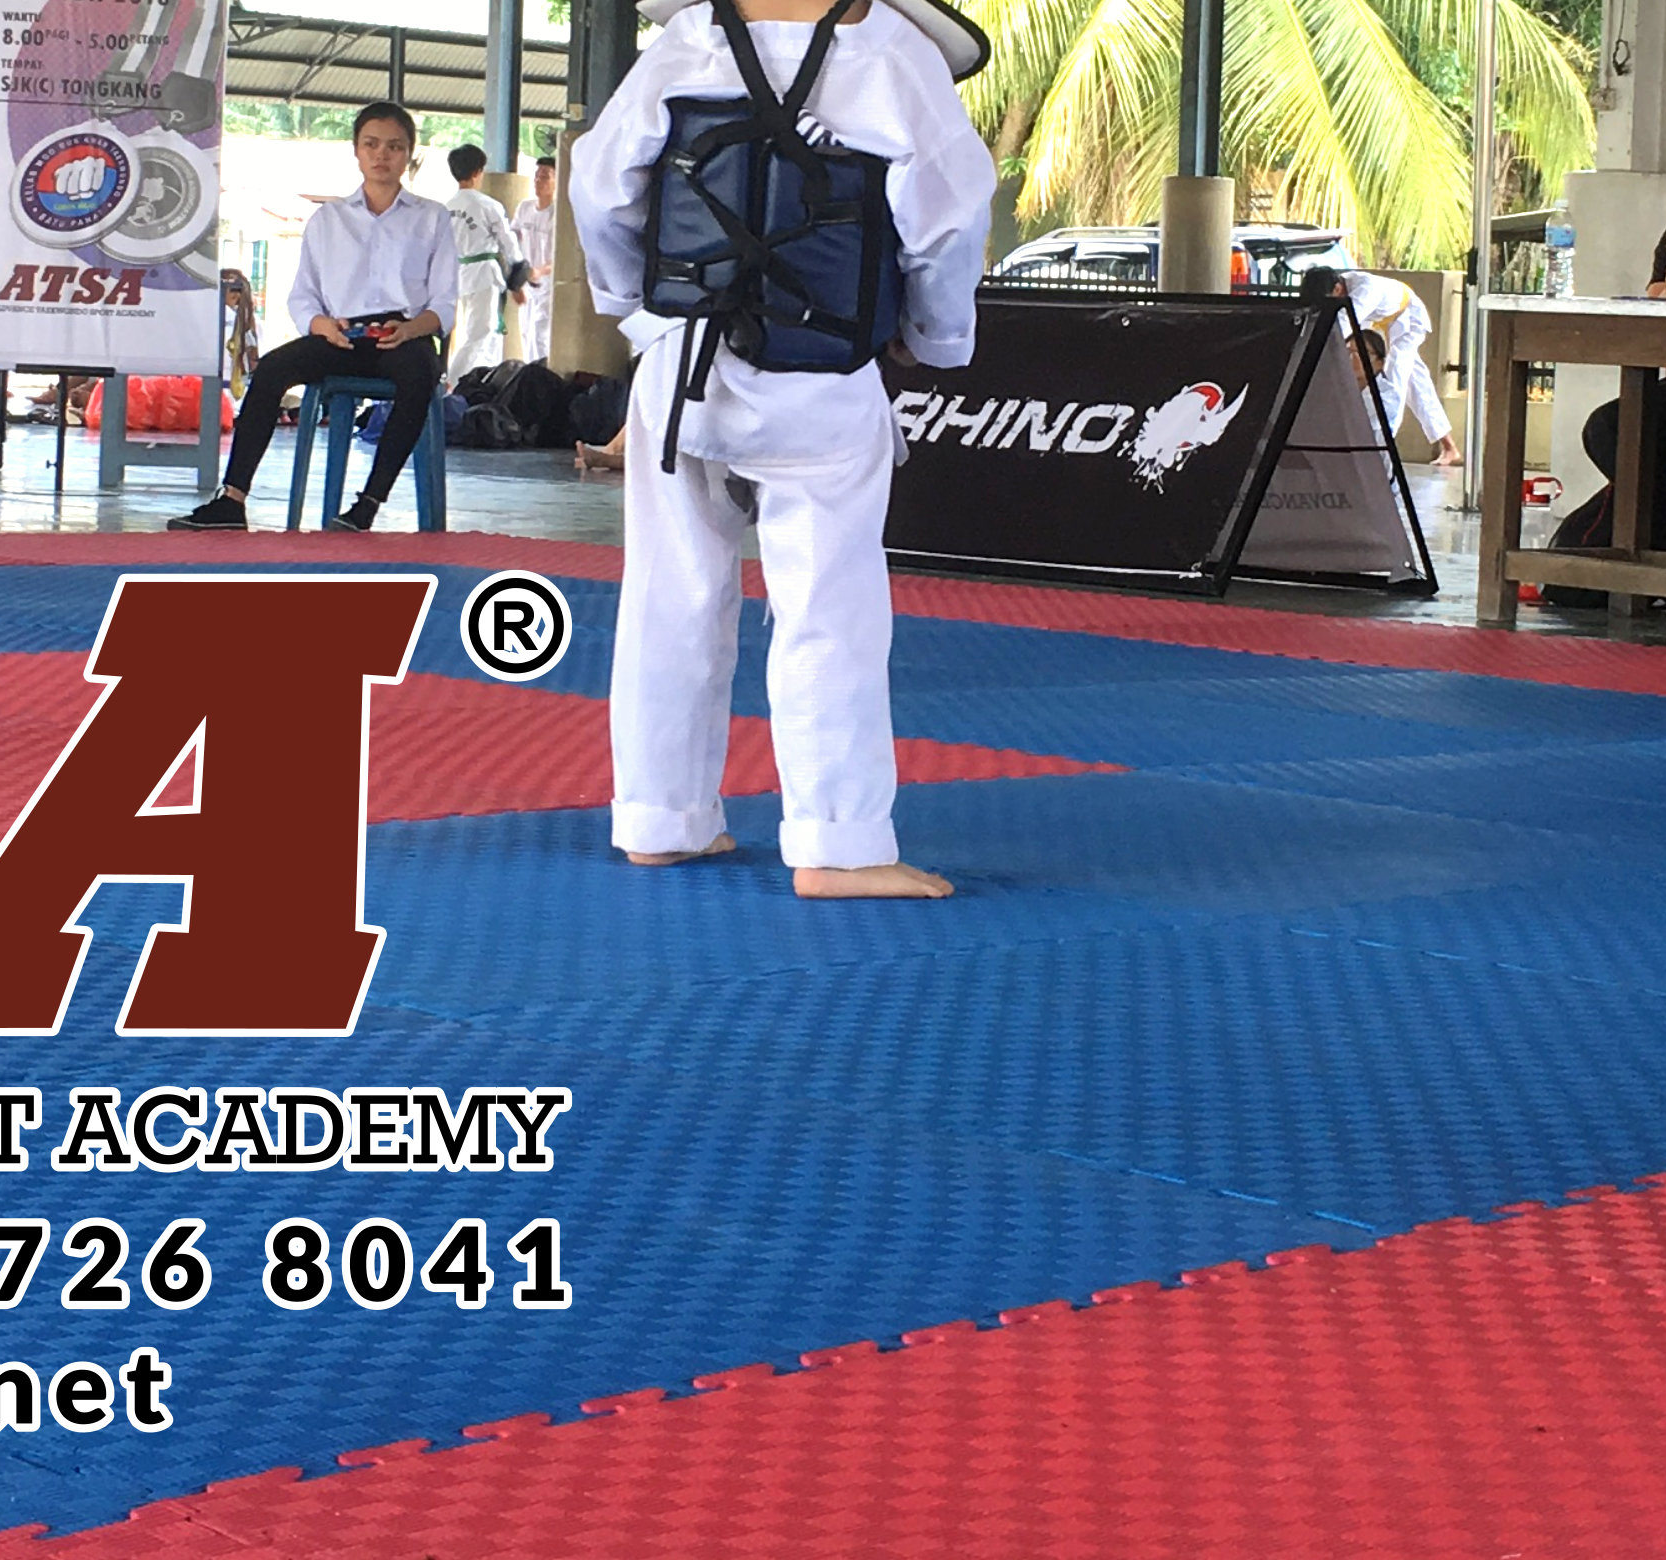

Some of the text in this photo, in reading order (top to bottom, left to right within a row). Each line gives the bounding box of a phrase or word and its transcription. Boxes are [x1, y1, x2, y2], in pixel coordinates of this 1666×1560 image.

[1, 75, 162, 100] SJK(C) TONGKANG
[891, 384, 1135, 455] RHINO
